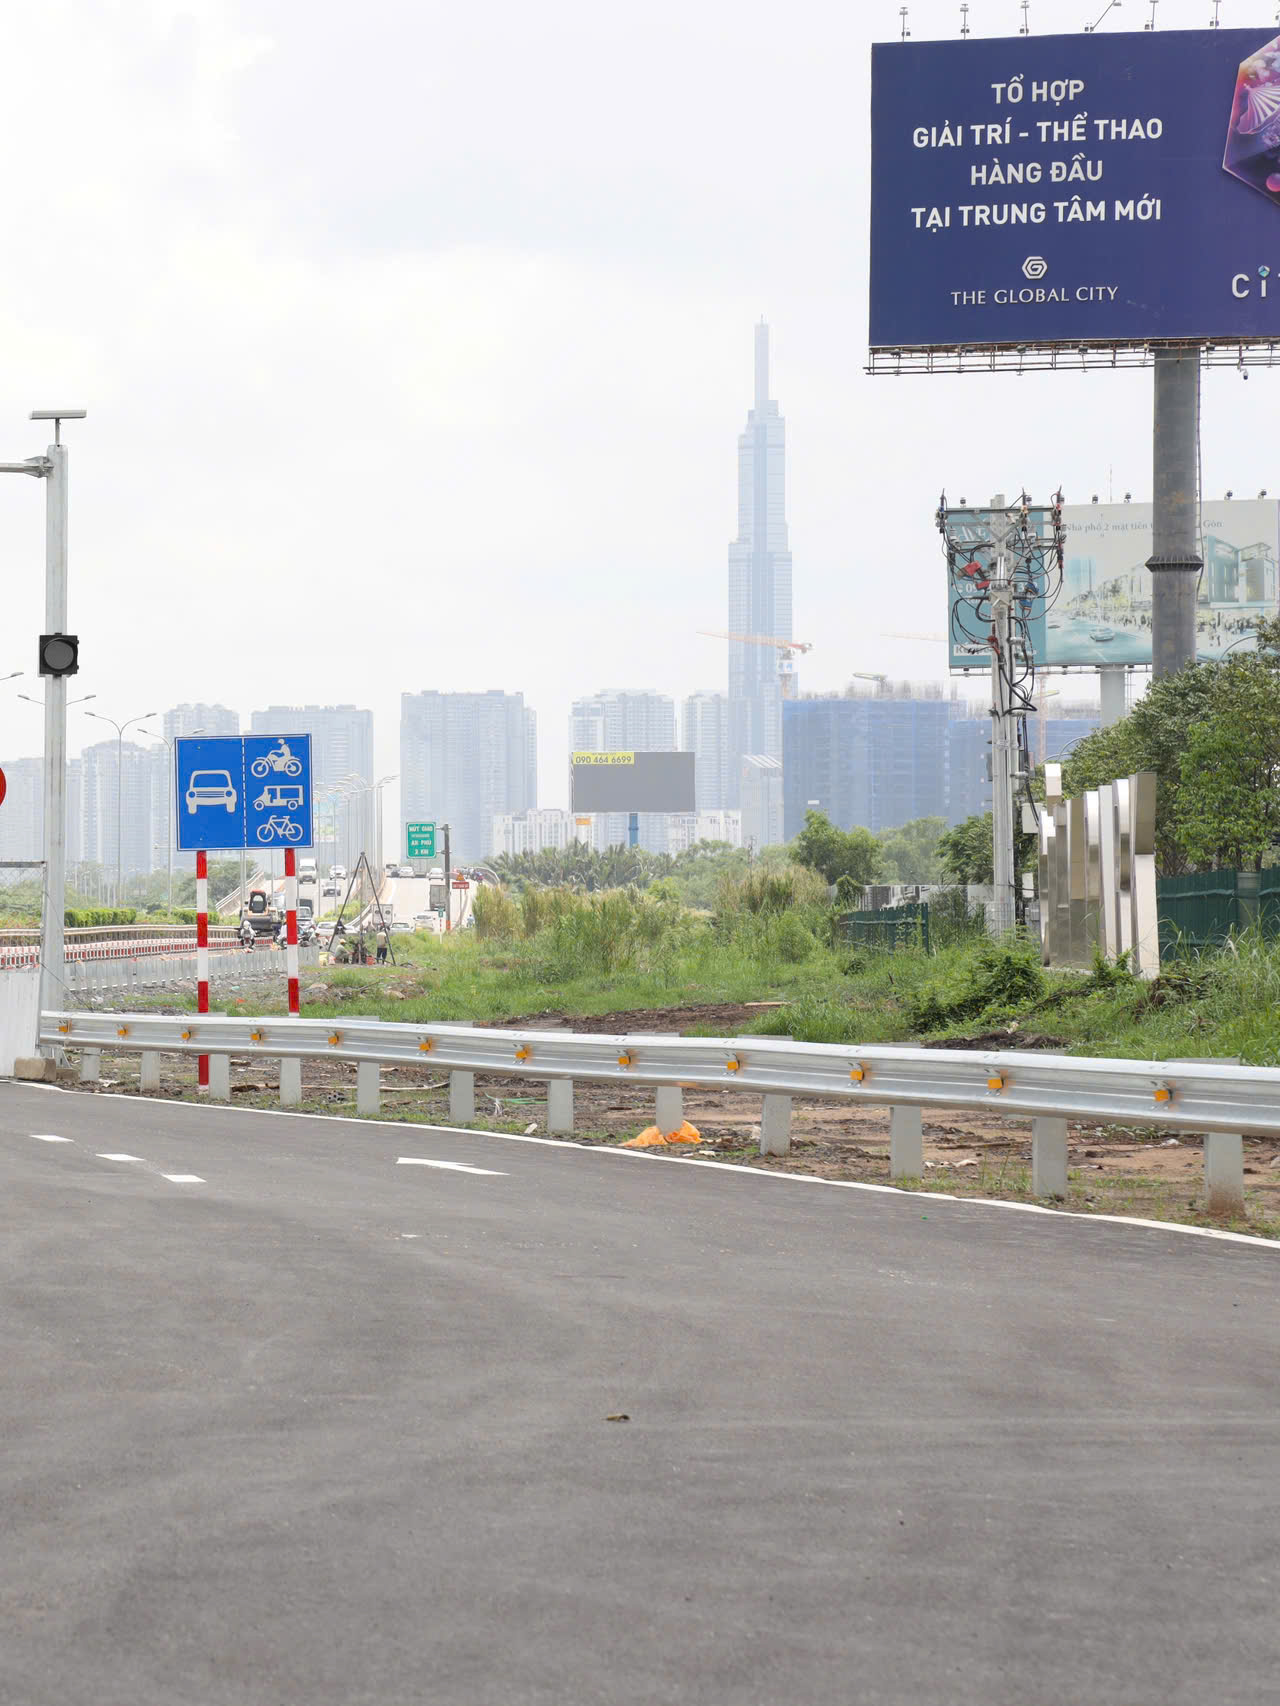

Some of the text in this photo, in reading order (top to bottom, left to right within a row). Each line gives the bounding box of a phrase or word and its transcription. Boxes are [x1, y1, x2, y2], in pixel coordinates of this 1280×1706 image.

[991, 73, 1085, 106] TỔ HỢP
[913, 119, 963, 148] GIẢI
[970, 117, 1012, 146] TRÍ
[1036, 111, 1088, 142] THỂ
[1094, 117, 1163, 140] THAO
[970, 152, 1103, 185] HÀNG ĐẦU
[911, 193, 1162, 232] TẠI TRUNG TÂM MỚI
[950, 286, 1119, 305] THE GLOBAL CITY
[575, 755, 632, 764] 090 464 6699
